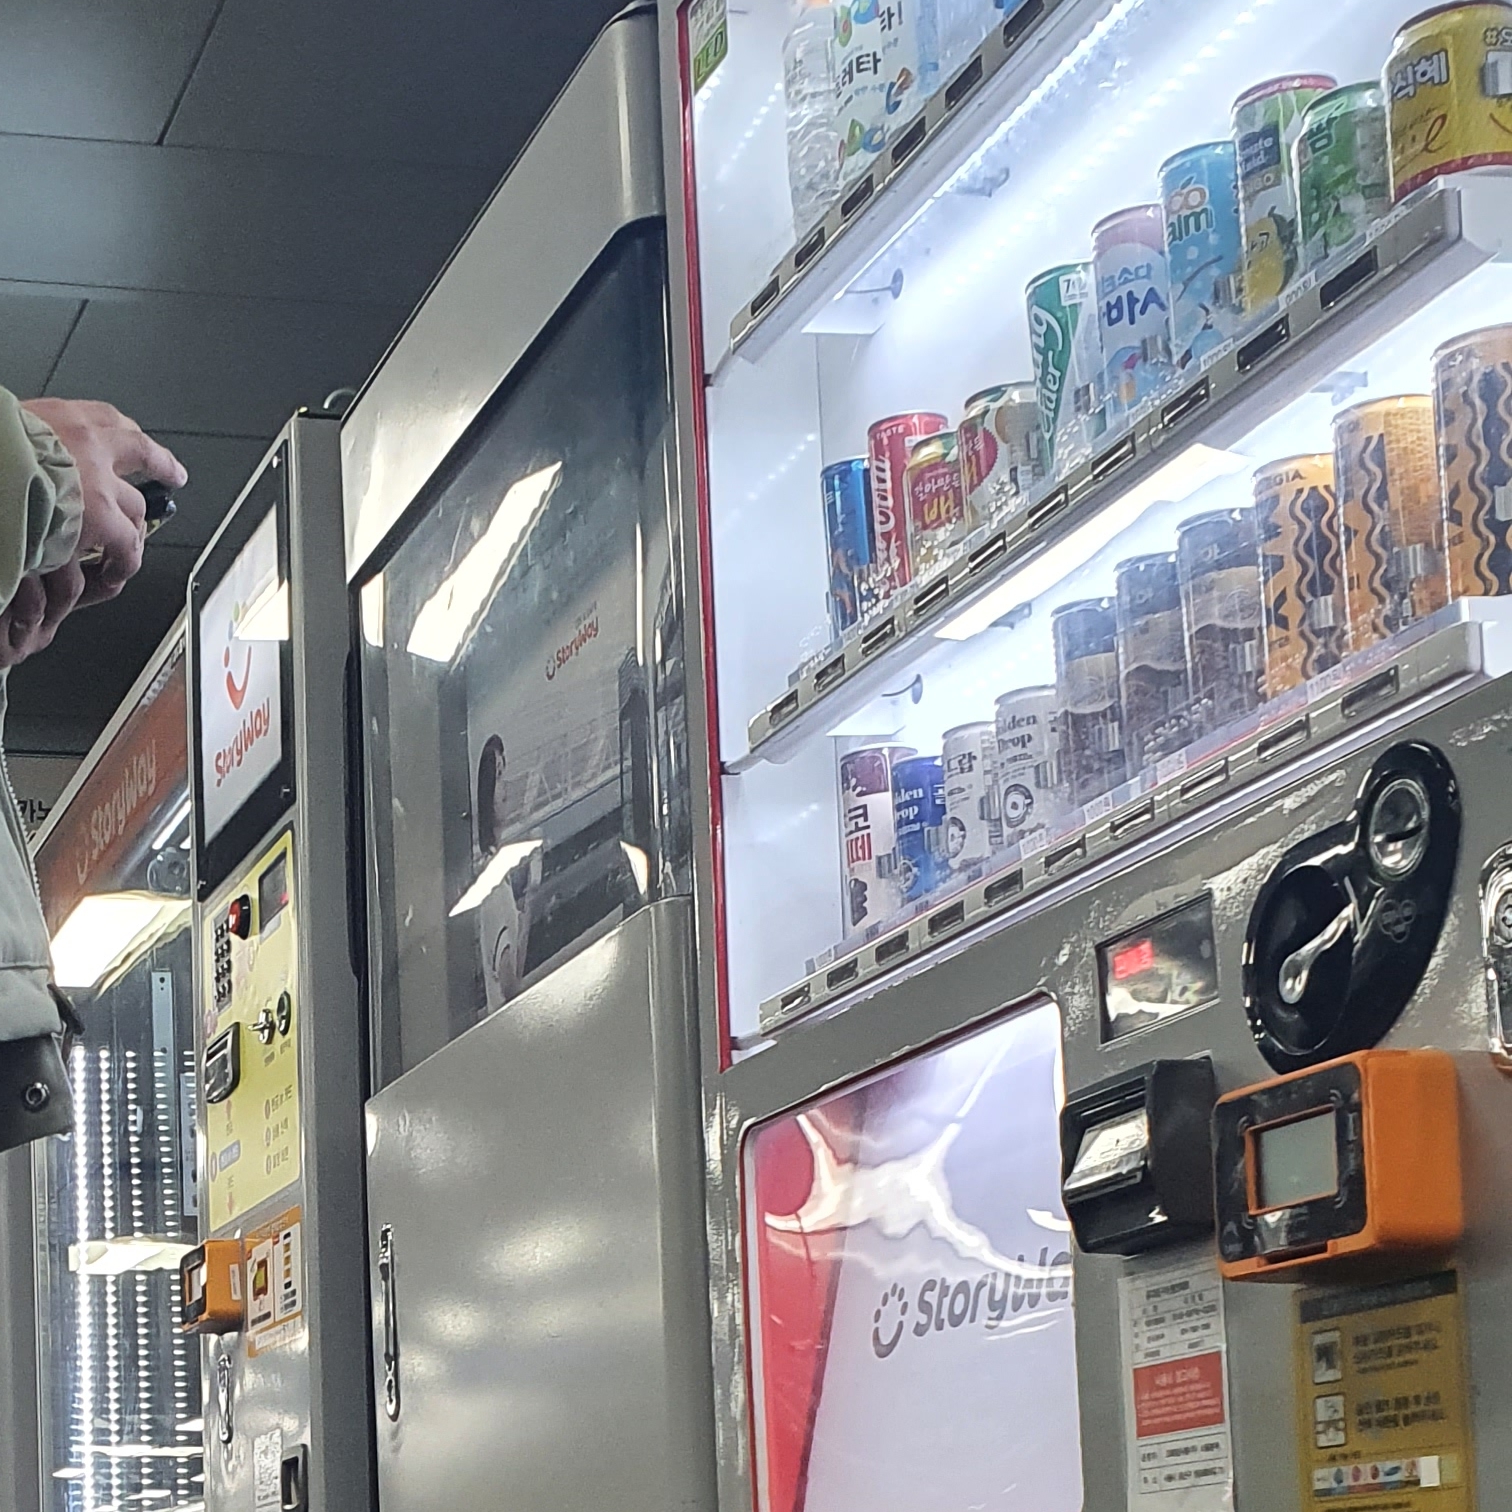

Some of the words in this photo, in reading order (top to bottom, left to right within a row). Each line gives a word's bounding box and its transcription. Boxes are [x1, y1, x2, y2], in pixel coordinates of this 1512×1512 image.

[215, 697, 271, 788] StoryWay
[90, 738, 157, 861] StoryWay
[895, 787, 924, 804] lden
[896, 805, 919, 820] rop
[912, 1245, 1073, 1339] StoryWa
